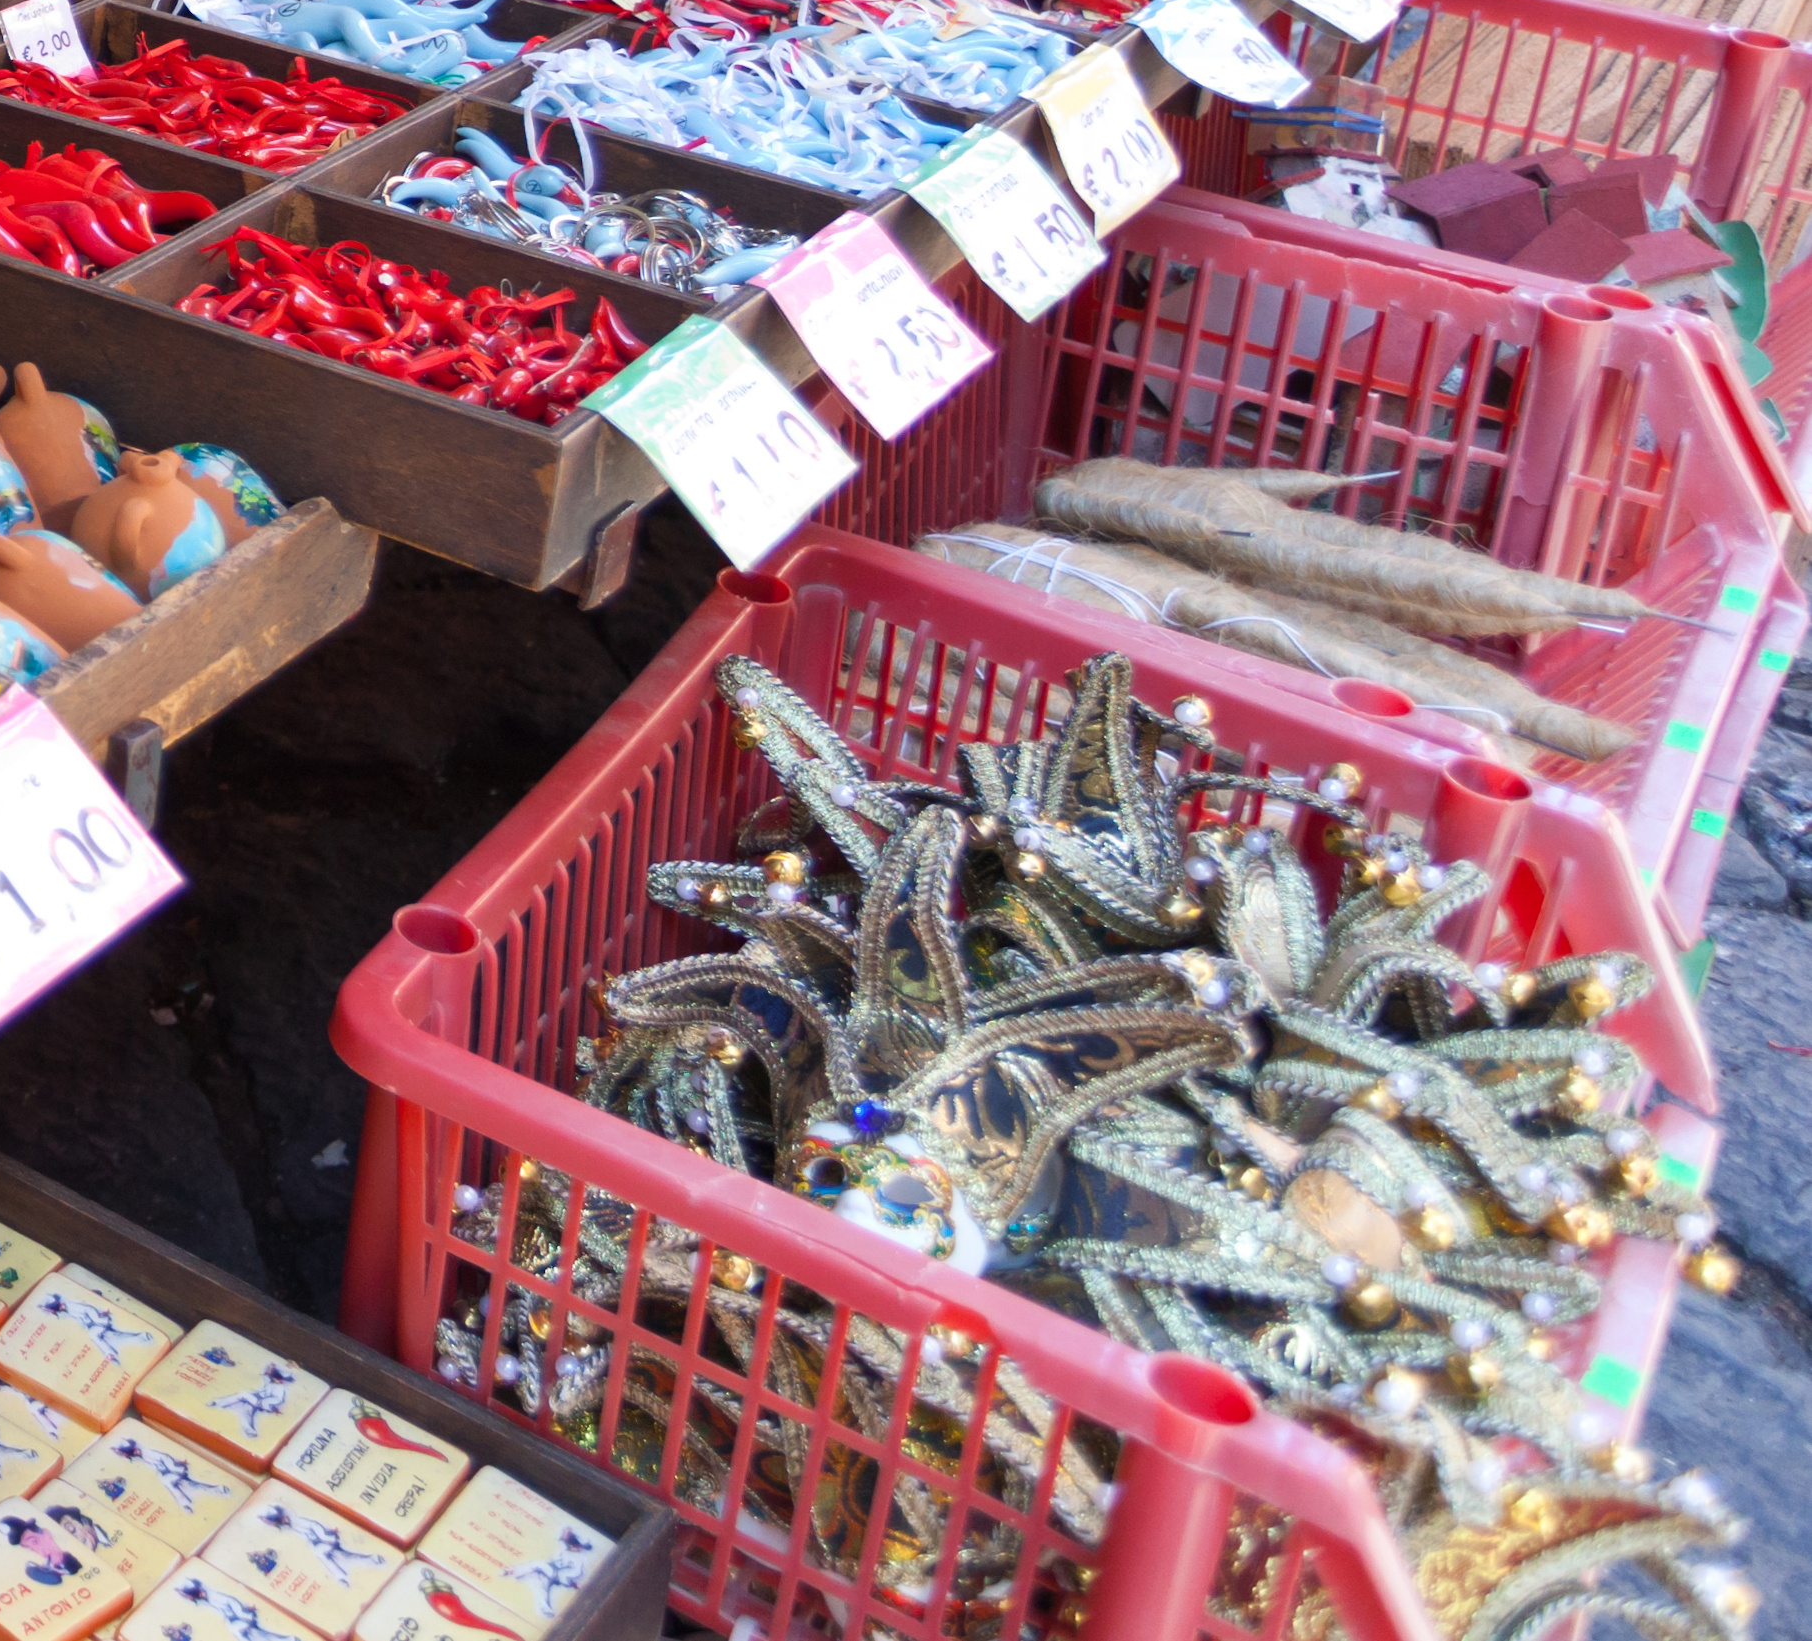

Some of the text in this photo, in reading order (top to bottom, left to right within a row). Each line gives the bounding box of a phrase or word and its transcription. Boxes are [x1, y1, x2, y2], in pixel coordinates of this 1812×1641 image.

[38, 30, 72, 59] 2,00
[295, 1427, 337, 1471] FORTUNA
[325, 1439, 370, 1493] ASSISTIMI
[359, 1460, 398, 1506] INVIDIA
[394, 1477, 430, 1519] CREPA!
[20, 1586, 92, 1636] ANTONIO
